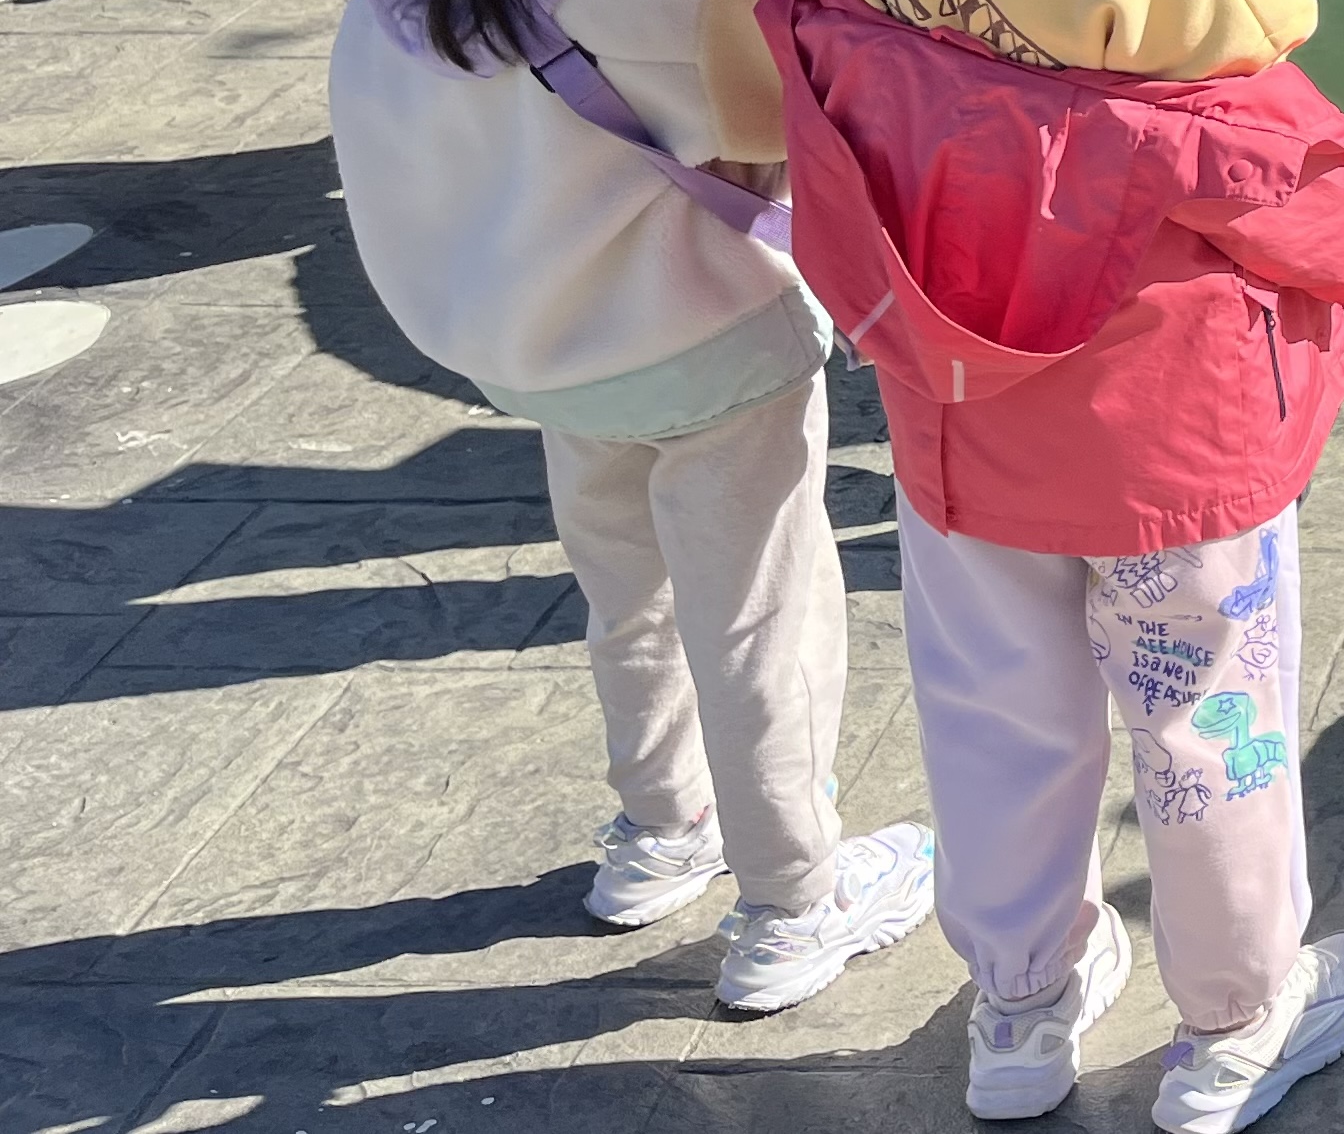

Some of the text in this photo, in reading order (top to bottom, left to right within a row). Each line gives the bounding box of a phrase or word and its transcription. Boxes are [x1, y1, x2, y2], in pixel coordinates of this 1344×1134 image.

[1115, 613, 1170, 637] IN THE
[1172, 638, 1215, 667] HOUSE
